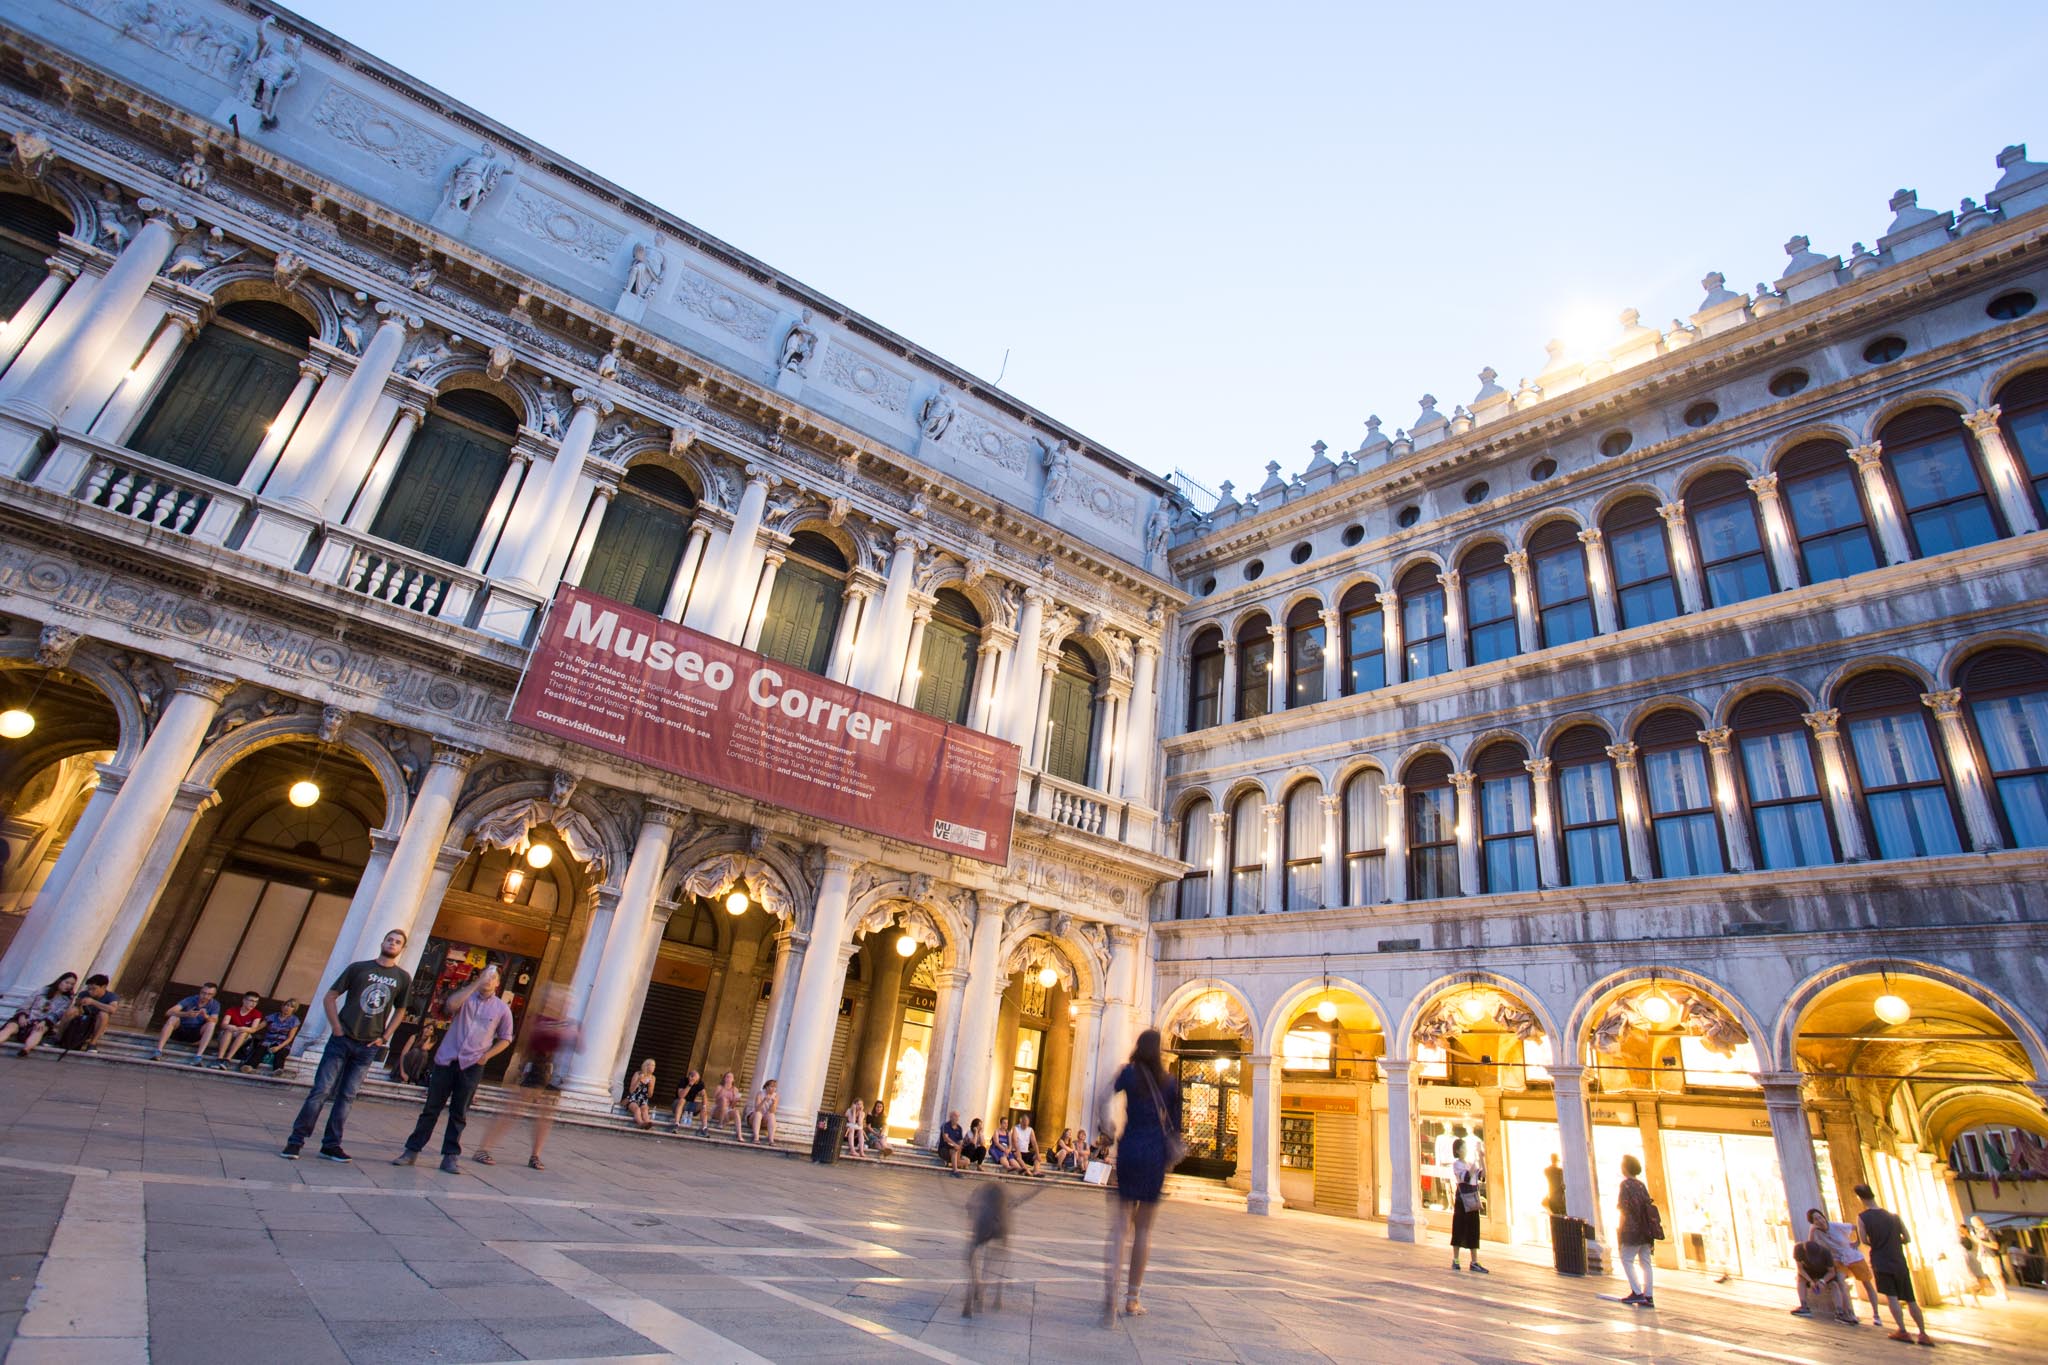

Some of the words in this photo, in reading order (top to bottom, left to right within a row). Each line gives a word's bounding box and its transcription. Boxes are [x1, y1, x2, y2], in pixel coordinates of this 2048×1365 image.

[551, 670, 577, 683] rooms
[579, 680, 593, 688] and
[595, 685, 627, 699] Antonio
[554, 660, 563, 668] of
[565, 664, 579, 673] the
[581, 669, 615, 685] Princess
[648, 692, 659, 700] the
[661, 697, 707, 716] neoclassical
[559, 651, 573, 659] The
[575, 656, 597, 669] Royal
[629, 675, 641, 684] the
[643, 680, 672, 694] Imperial
[673, 691, 718, 710] Apartments
[564, 601, 734, 691] Museo
[748, 675, 892, 745] Correr
[544, 688, 587, 707] Festivities
[588, 703, 604, 713] and
[606, 710, 624, 720] wars
[548, 679, 563, 688] The
[564, 684, 593, 699] History
[644, 712, 665, 723] Doge
[667, 719, 681, 728] and
[683, 724, 695, 733] the
[535, 709, 626, 743] correr.visitmuve.it
[737, 712, 750, 721] The
[752, 718, 764, 726] new
[766, 723, 794, 736] Venetian
[732, 731, 758, 744] Lorenzo
[796, 752, 822, 765] Giovanni
[847, 768, 867, 779] Vittore
[735, 722, 747, 730] and
[749, 726, 760, 734] the
[761, 730, 811, 753] Picture-gallery
[828, 753, 846, 763] works
[848, 759, 855, 767] by
[947, 752, 975, 767] Temporary
[727, 749, 753, 762] Lorenzo
[793, 771, 811, 781] much
[813, 778, 830, 787] more
[842, 785, 871, 799] discover!
[809, 766, 839, 780] Antonello
[936, 821, 950, 831] MU
[936, 829, 949, 839] VE
[368, 973, 397, 988] SPARTA
[1444, 1097, 1472, 1107] BOSS
